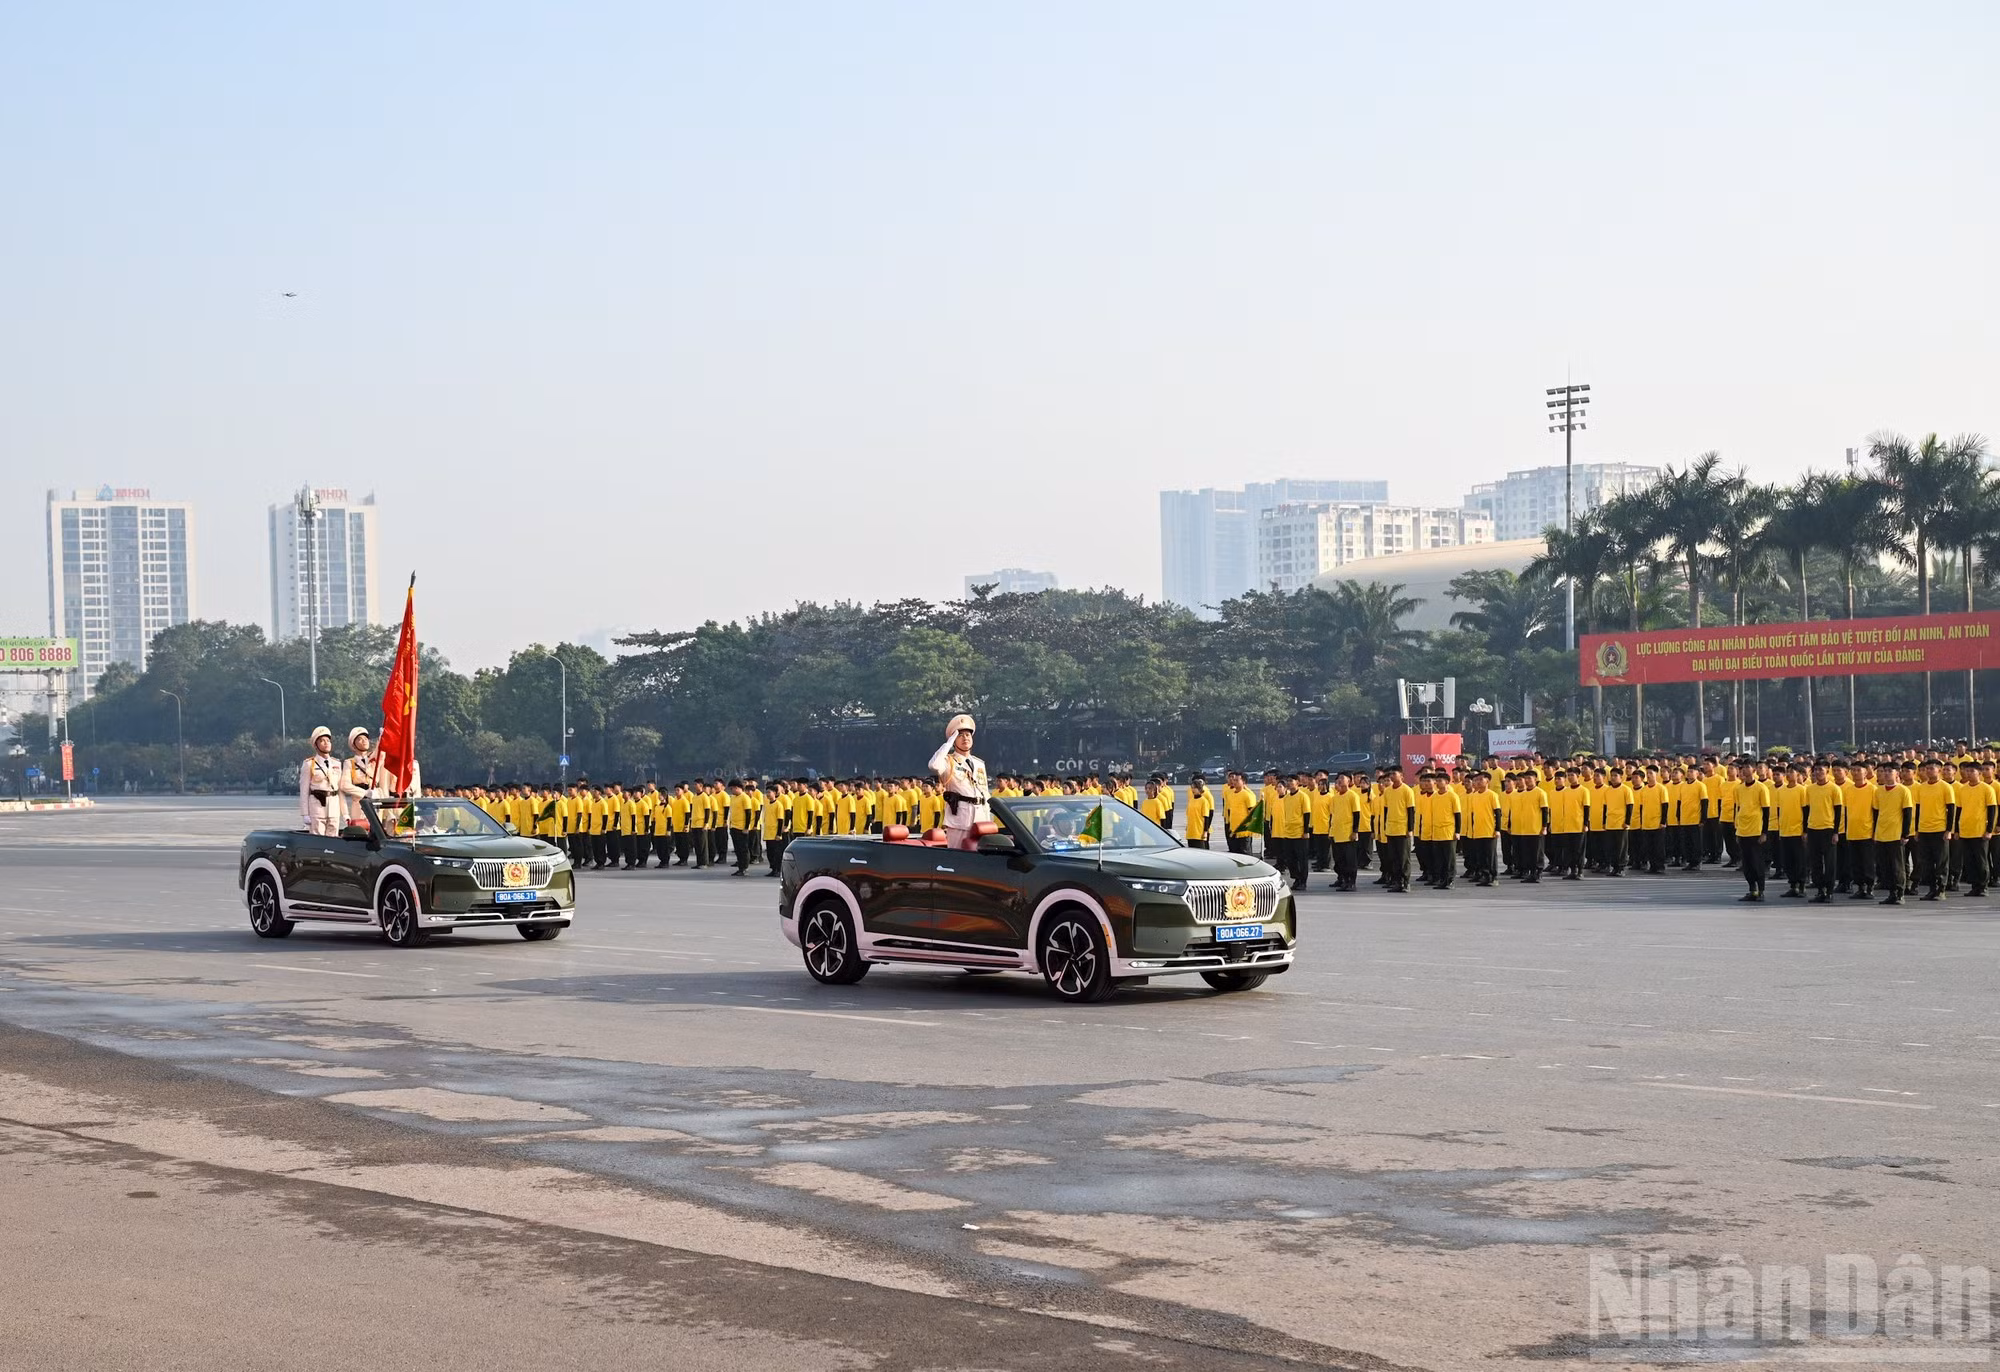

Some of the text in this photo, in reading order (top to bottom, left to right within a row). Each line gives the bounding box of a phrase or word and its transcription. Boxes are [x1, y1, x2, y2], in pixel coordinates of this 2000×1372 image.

[1636, 621, 1990, 658] LỰC LƯỢNG CÔNG AN NHÂN DÂN QUYẾT TÂM BẢO VỆ TUYỆT ĐỐI AN NINH, AN TOÀN
[10, 647, 34, 661] 806
[39, 647, 72, 661] 8888
[1692, 658, 1706, 674] ĐẠI
[1708, 655, 1723, 673] HỘI
[1725, 657, 1740, 673] ĐẠI
[1742, 652, 1762, 669] BIỂU
[1764, 652, 1788, 668] TOÀN
[1790, 649, 1815, 668] QUỐC
[1837, 648, 1855, 665] THỨ
[1856, 651, 1872, 664] XIV
[1874, 646, 1893, 664] CỦA
[1895, 645, 1925, 662] ĐẢNG!
[1220, 926, 1260, 939] 80A-066.27
